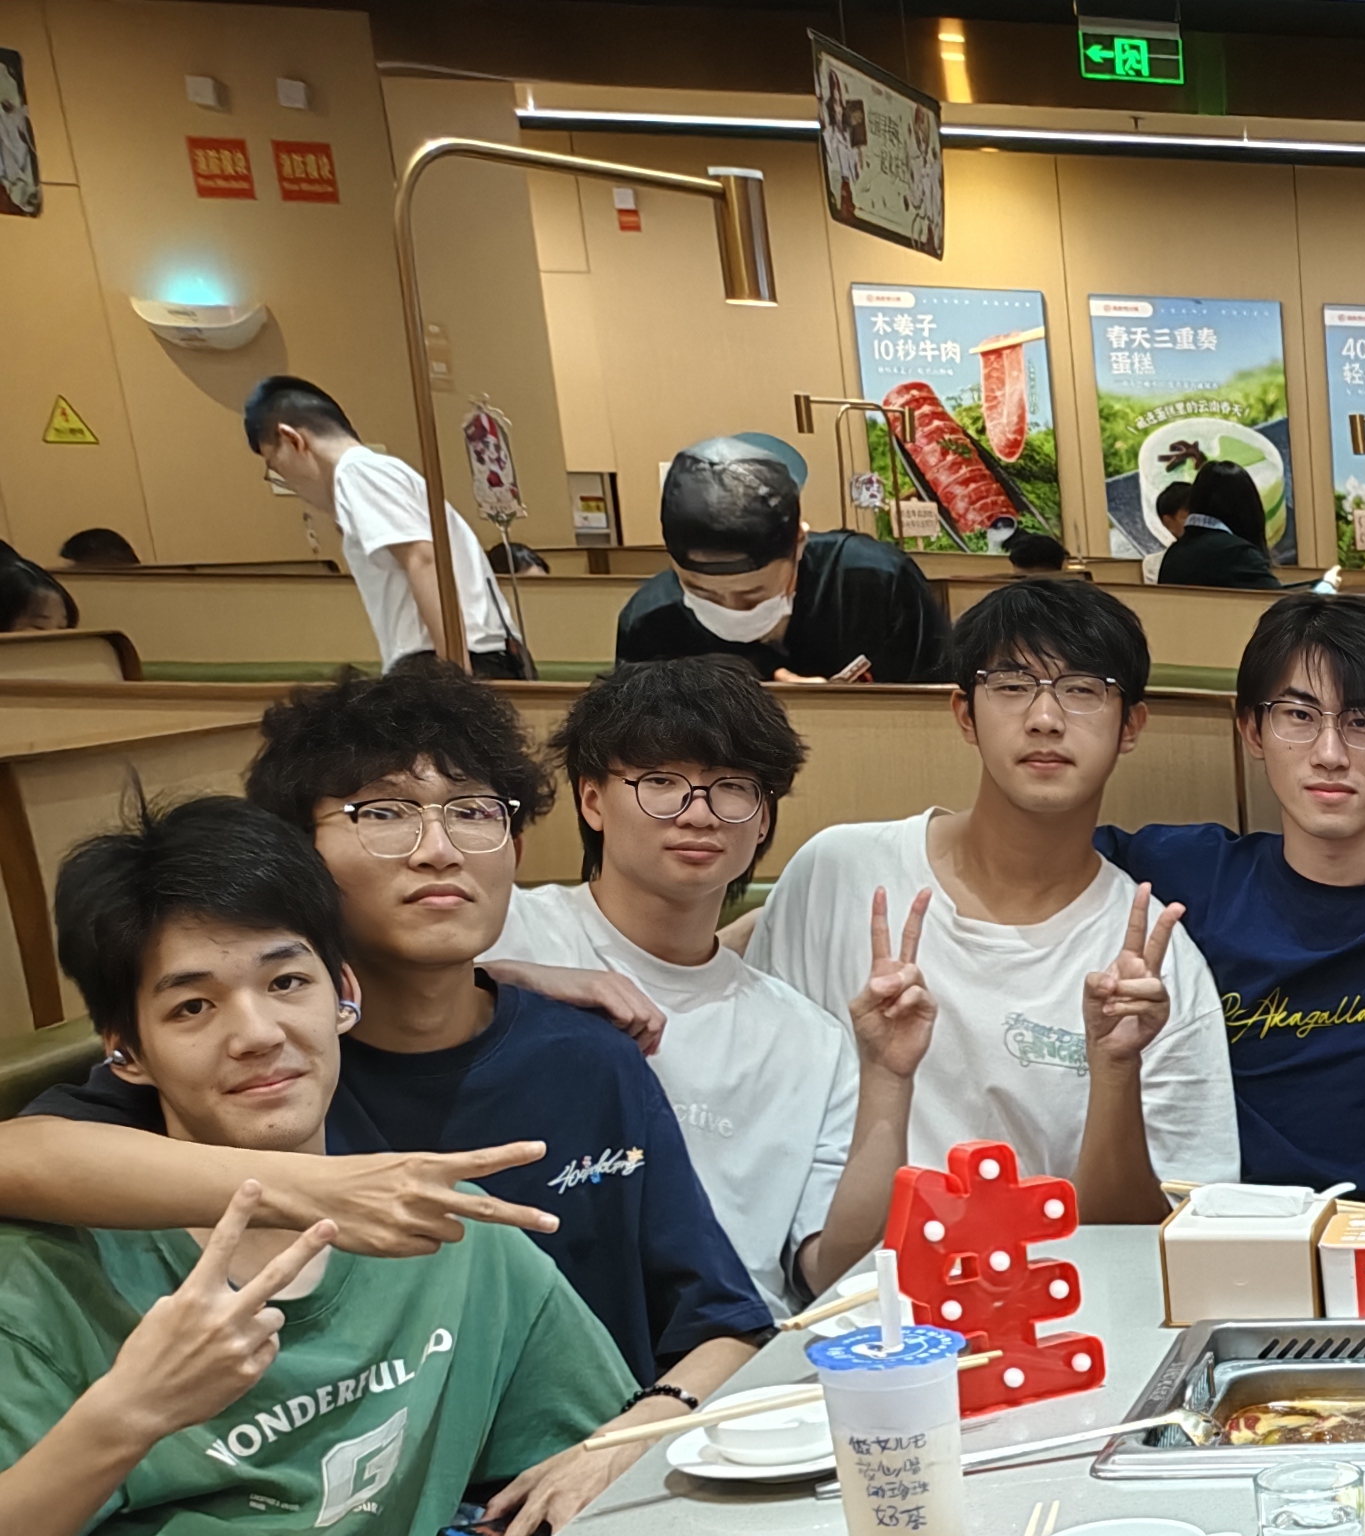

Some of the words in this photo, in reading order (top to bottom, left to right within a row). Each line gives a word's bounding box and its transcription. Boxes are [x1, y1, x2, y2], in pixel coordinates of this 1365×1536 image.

[870, 312, 937, 337] 木姜子
[1106, 325, 1218, 351] 春天三重奏
[873, 339, 961, 364] 10秒牛肉
[1110, 351, 1156, 375] 蛋糕
